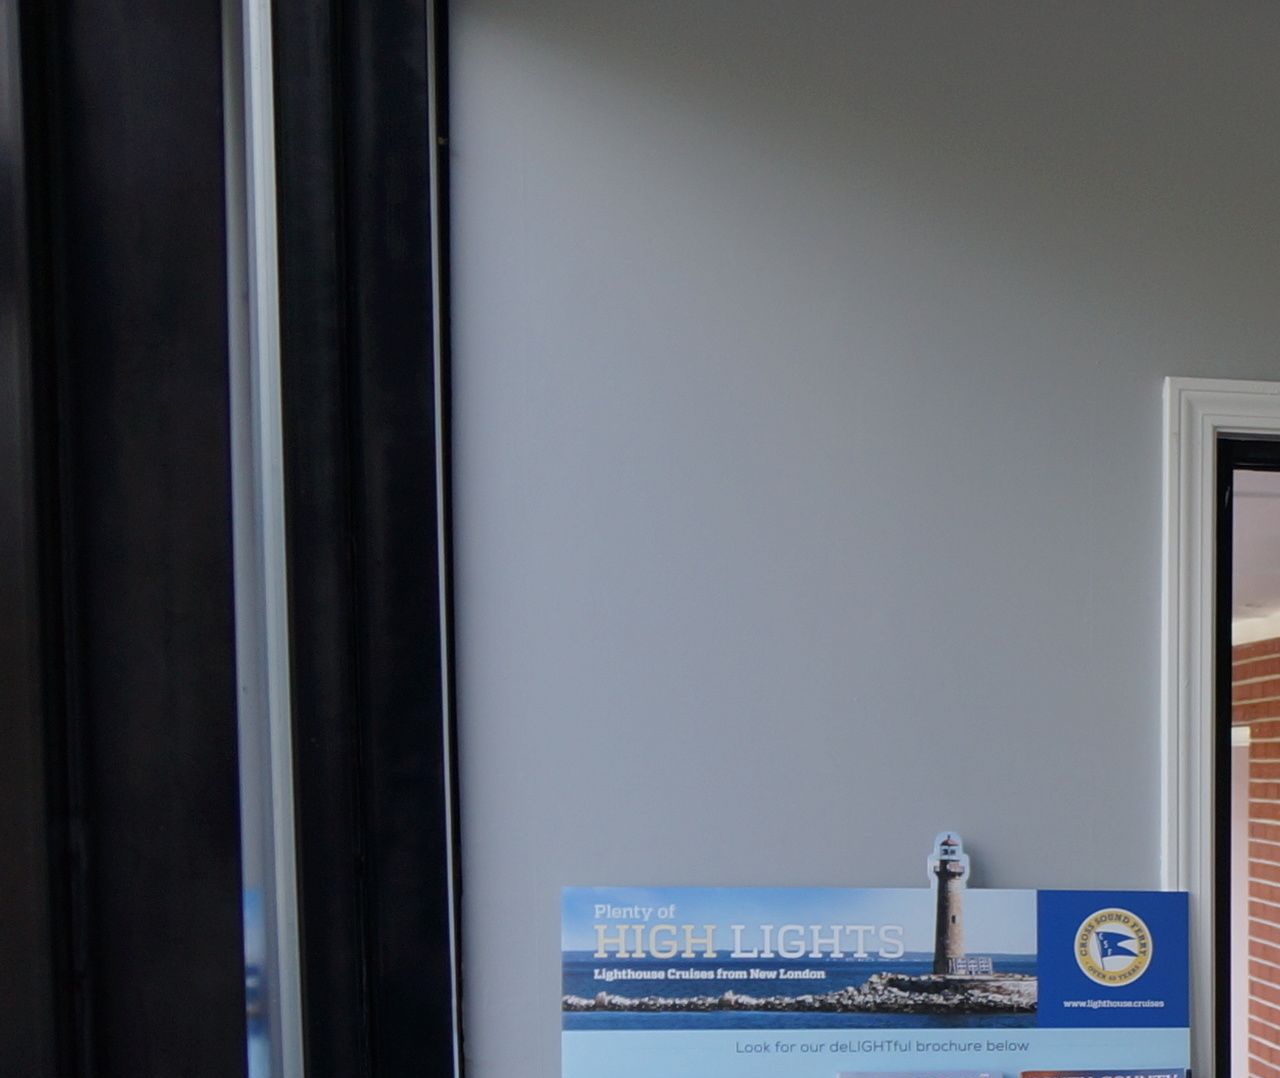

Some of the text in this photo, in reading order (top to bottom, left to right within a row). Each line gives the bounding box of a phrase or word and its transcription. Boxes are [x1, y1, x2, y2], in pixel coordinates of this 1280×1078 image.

[593, 903, 676, 921] Plenty of
[593, 924, 905, 959] HIGH LIGHTS
[1079, 912, 1148, 957] CROSS SOUND FERRY
[593, 968, 826, 981] Lighthouse Cruises from New London
[1063, 999, 1165, 1009] www.lighthouse.cruises
[736, 1039, 1030, 1054] Look for our deLIGHTful brochure below
